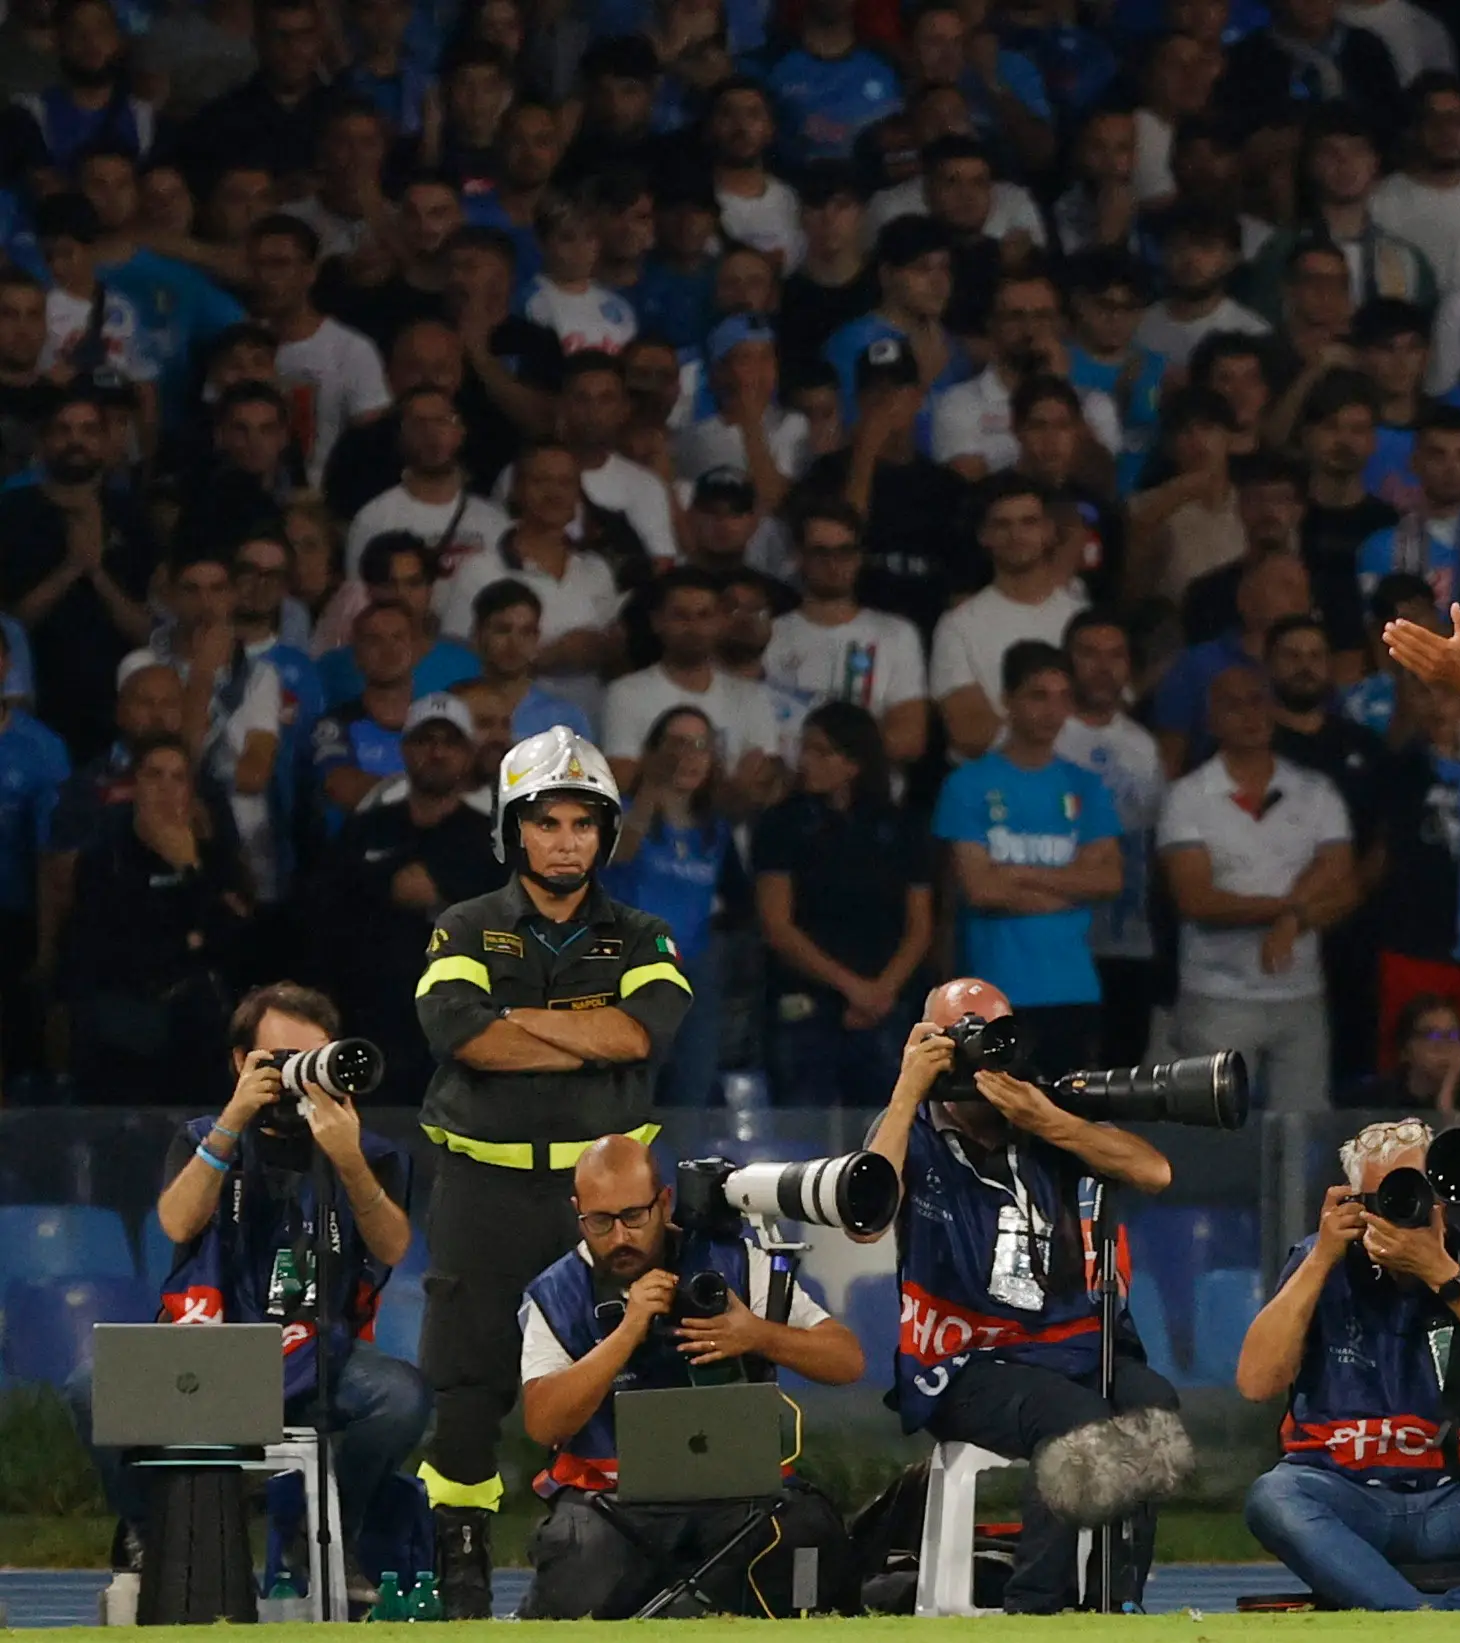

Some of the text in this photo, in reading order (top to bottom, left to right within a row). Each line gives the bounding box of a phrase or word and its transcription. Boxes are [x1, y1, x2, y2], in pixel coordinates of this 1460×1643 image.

[232, 1179, 242, 1224] SONY
[329, 1211, 341, 1254] SONY
[901, 1293, 1018, 1356] PHOT
